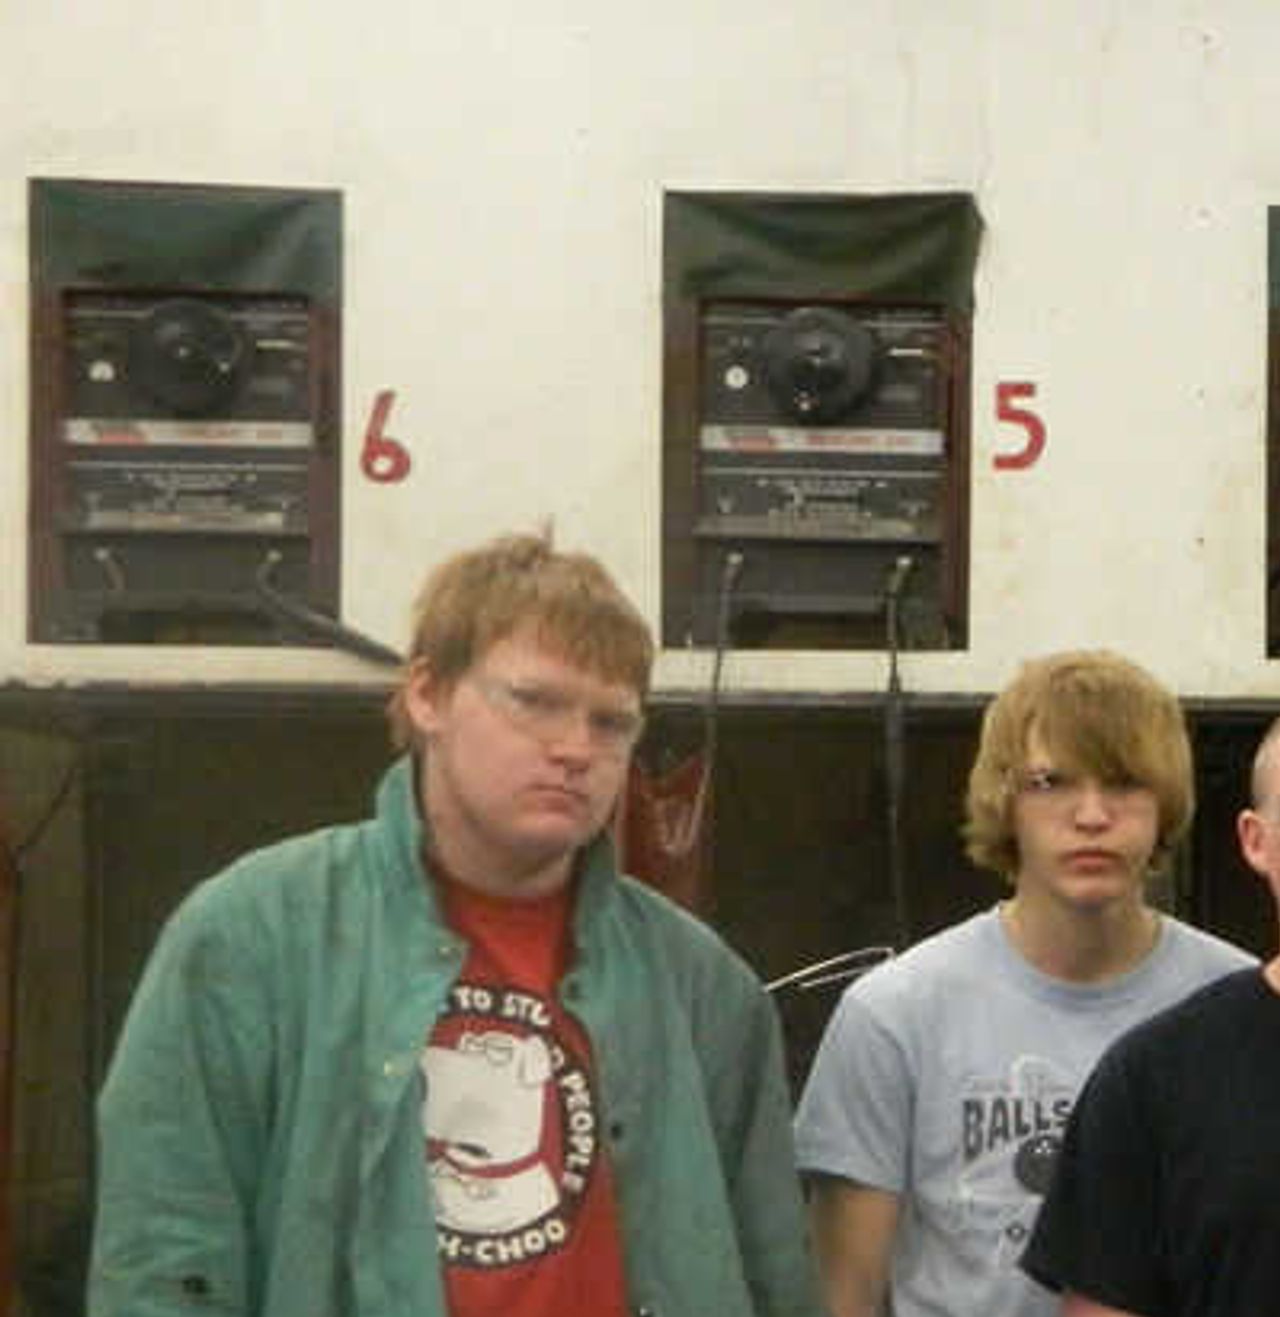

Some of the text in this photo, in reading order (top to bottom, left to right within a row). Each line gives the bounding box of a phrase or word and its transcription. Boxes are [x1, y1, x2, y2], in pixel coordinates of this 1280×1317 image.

[360, 390, 411, 484] 6
[993, 382, 1047, 472] 5
[454, 984, 492, 1011] TO
[560, 1071, 594, 1193] PEOPLE
[437, 1218, 567, 1263] H-CHOO
